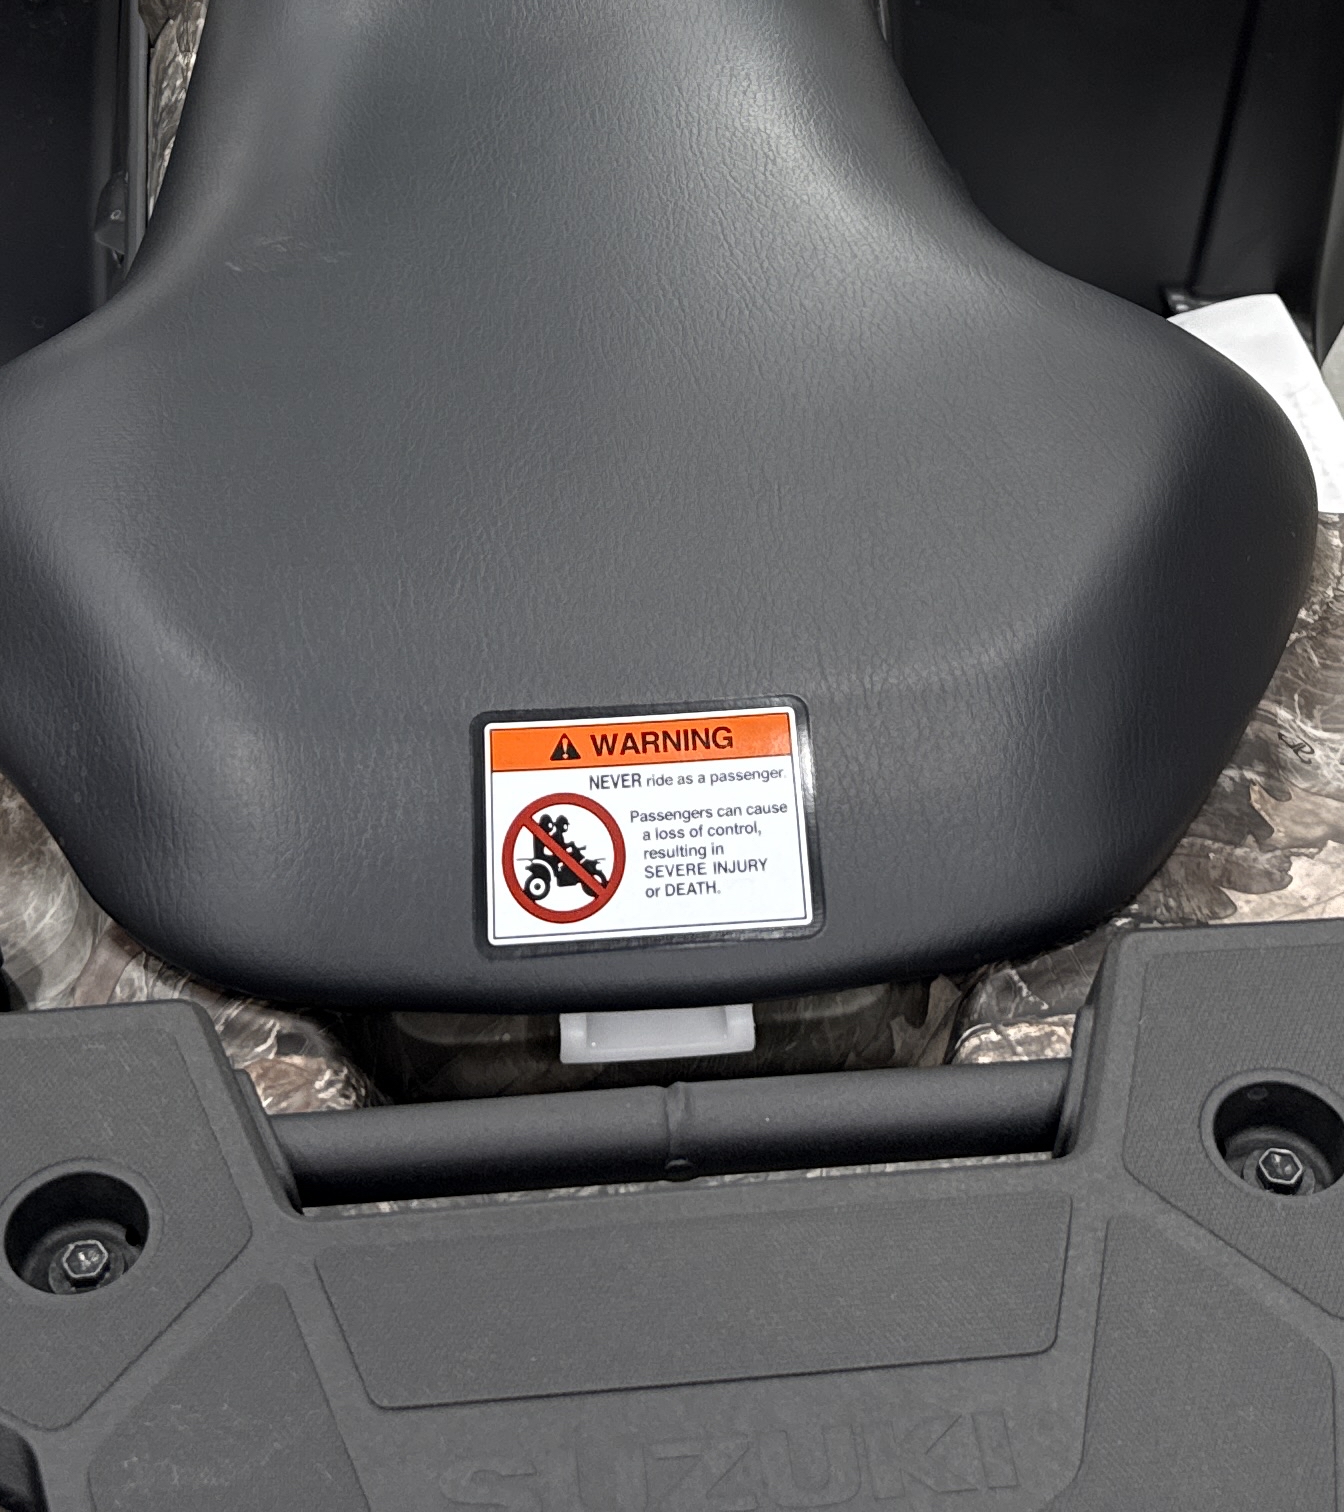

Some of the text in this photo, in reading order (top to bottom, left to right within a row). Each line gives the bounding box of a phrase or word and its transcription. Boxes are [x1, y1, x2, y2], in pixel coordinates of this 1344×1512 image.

[590, 727, 733, 757] WARNING
[589, 773, 642, 791] NEVER
[646, 772, 673, 787] ride
[677, 775, 693, 785] as
[697, 773, 706, 784] a
[630, 802, 788, 824] Passengers can cause
[642, 822, 762, 840] a loss of control,
[643, 843, 724, 861] resulting in
[644, 859, 768, 879] SEVERE INJURY
[646, 881, 721, 898] or DEATH.
[438, 1409, 1020, 1512] SUZUKI
